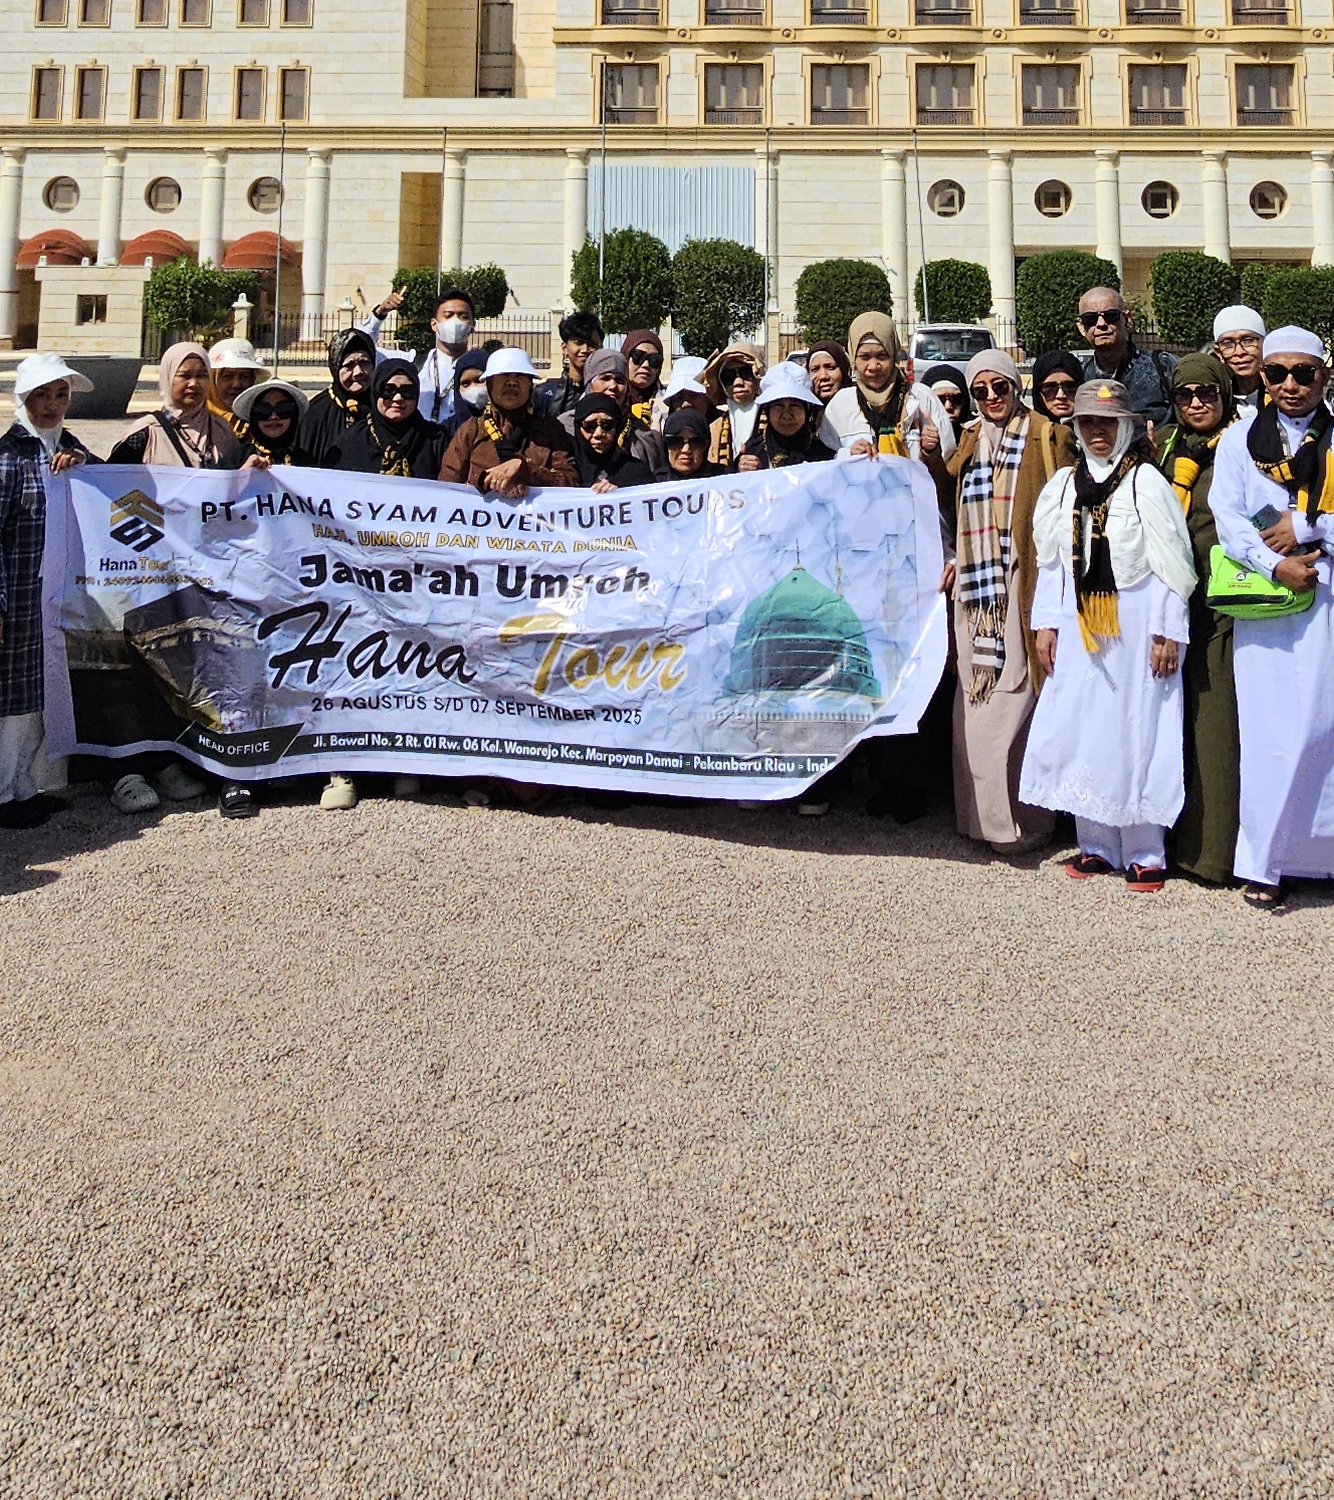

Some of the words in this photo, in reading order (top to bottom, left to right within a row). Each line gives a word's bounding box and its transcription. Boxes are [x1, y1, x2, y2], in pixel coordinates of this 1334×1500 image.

[201, 500, 249, 523] PT.
[255, 492, 335, 520] HANA
[345, 500, 439, 523] SYAM
[447, 501, 633, 533] ADVENTURE
[358, 530, 430, 548] UMROH
[435, 532, 479, 549] DAN
[485, 536, 568, 554] WISATA
[573, 535, 638, 553] DUNIA
[299, 553, 479, 597] Jama'ah
[257, 599, 478, 689] Hana
[499, 612, 686, 696] Tour
[312, 697, 334, 712] 26
[341, 694, 427, 710] AGUSTUS
[433, 696, 464, 713] S/D
[470, 698, 488, 714] 07
[495, 700, 597, 722] SEPTEMBER
[602, 707, 643, 725] 2025
[198, 734, 225, 754] HEAD
[227, 741, 271, 756] OFFICE
[330, 734, 369, 748] Bawal
[371, 735, 392, 748] No.
[394, 735, 404, 748] 2
[405, 735, 422, 749] Rt.
[423, 736, 438, 749] 01
[439, 737, 461, 751] Rw.
[462, 737, 479, 751] 06
[480, 739, 503, 753] Kel.
[504, 742, 559, 761] Wonorejo
[560, 746, 584, 760] Kec.
[585, 748, 644, 768] Marpoyan
[645, 752, 683, 769] Damai
[693, 755, 762, 773] Pekanbaru
[764, 757, 795, 773] Riau
